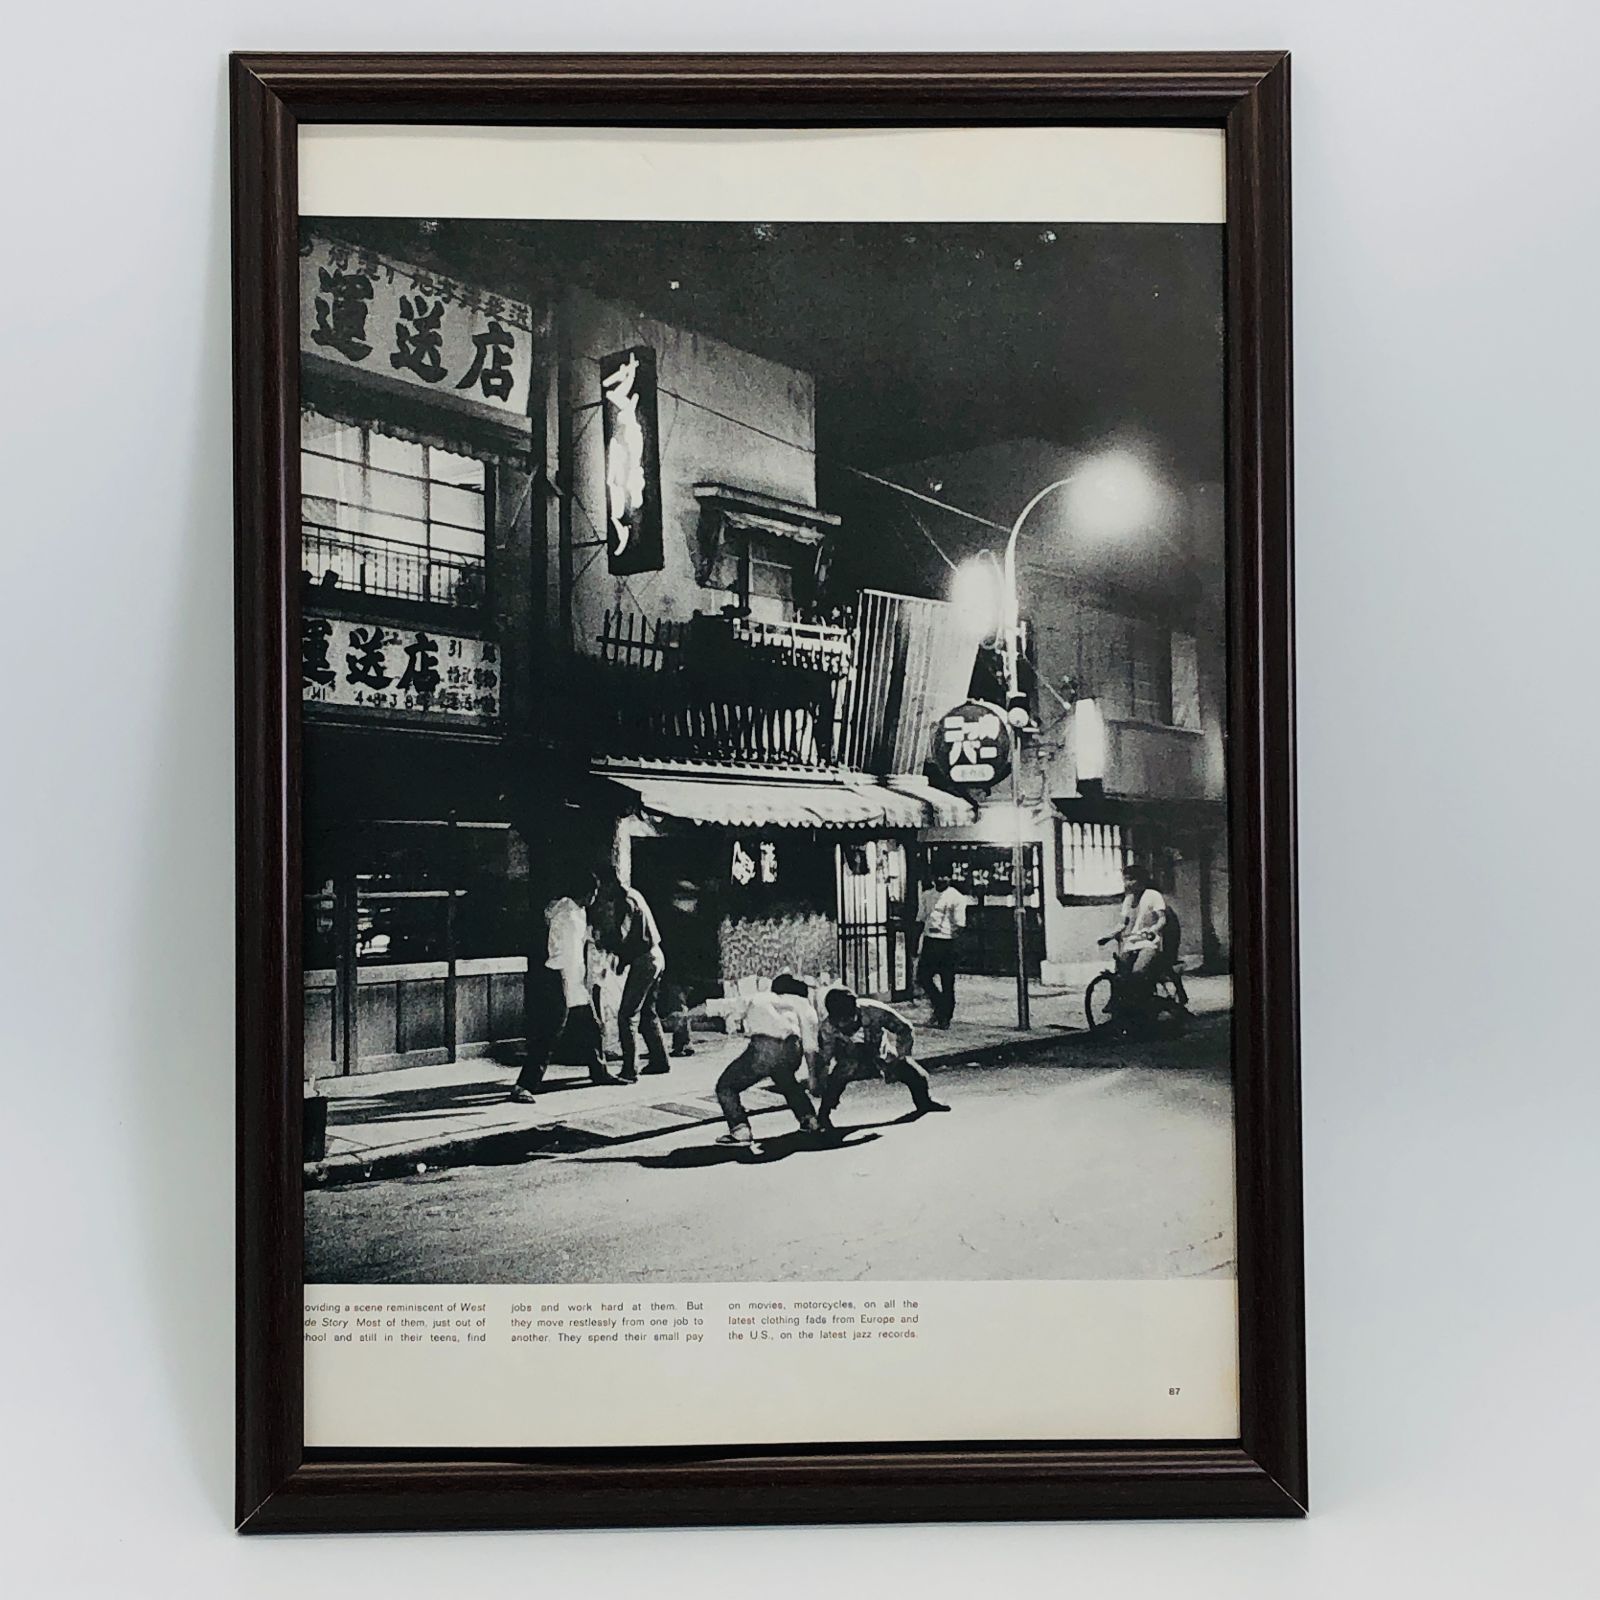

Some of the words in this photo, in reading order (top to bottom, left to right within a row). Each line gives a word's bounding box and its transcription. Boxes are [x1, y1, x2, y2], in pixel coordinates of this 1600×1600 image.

[344, 1304, 351, 1313] a
[353, 1304, 383, 1313] scene
[386, 1303, 444, 1313] reminiscent
[446, 1302, 457, 1313] of
[460, 1302, 487, 1313] West
[510, 1302, 532, 1314] jobs
[540, 1302, 560, 1313] and
[567, 1301, 593, 1312] work
[600, 1301, 624, 1312] hard
[631, 1302, 642, 1312] at
[686, 1300, 704, 1311] But
[728, 1302, 741, 1311] on
[748, 1300, 787, 1311] movies,
[793, 1299, 857, 1312] motorcycles,
[863, 1301, 877, 1309] on
[883, 1298, 896, 1309] all
[902, 1299, 919, 1309] the
[355, 1317, 381, 1328] Most
[385, 1317, 396, 1328] of
[400, 1317, 428, 1328] them,
[432, 1318, 451, 1329] just
[455, 1318, 472, 1328] out
[475, 1317, 487, 1328] of
[510, 1317, 533, 1330] they
[536, 1319, 564, 1328] move
[568, 1317, 618, 1329] restlessly
[621, 1316, 645, 1327] from
[649, 1318, 669, 1327] one
[672, 1316, 689, 1328] job
[693, 1317, 704, 1326] to
[728, 1315, 756, 1326] latest
[760, 1315, 800, 1327] clothing
[805, 1314, 827, 1325] fads
[831, 1314, 856, 1324] from
[860, 1313, 896, 1326] Europe
[900, 1313, 919, 1324] and
[333, 1332, 353, 1343] and
[359, 1332, 377, 1343] still
[384, 1332, 394, 1342] in
[400, 1332, 423, 1343] their
[429, 1333, 461, 1344] teens,
[467, 1332, 487, 1343] find
[557, 1332, 583, 1345] They
[587, 1332, 619, 1344] spend
[624, 1332, 648, 1342] their
[653, 1331, 680, 1342] small
[685, 1333, 704, 1344] pay
[728, 1330, 744, 1341] the
[779, 1331, 793, 1340] on
[798, 1330, 814, 1340] the
[819, 1329, 847, 1340] latest
[852, 1329, 872, 1341] jazz
[1168, 1387, 1181, 1396] 87
